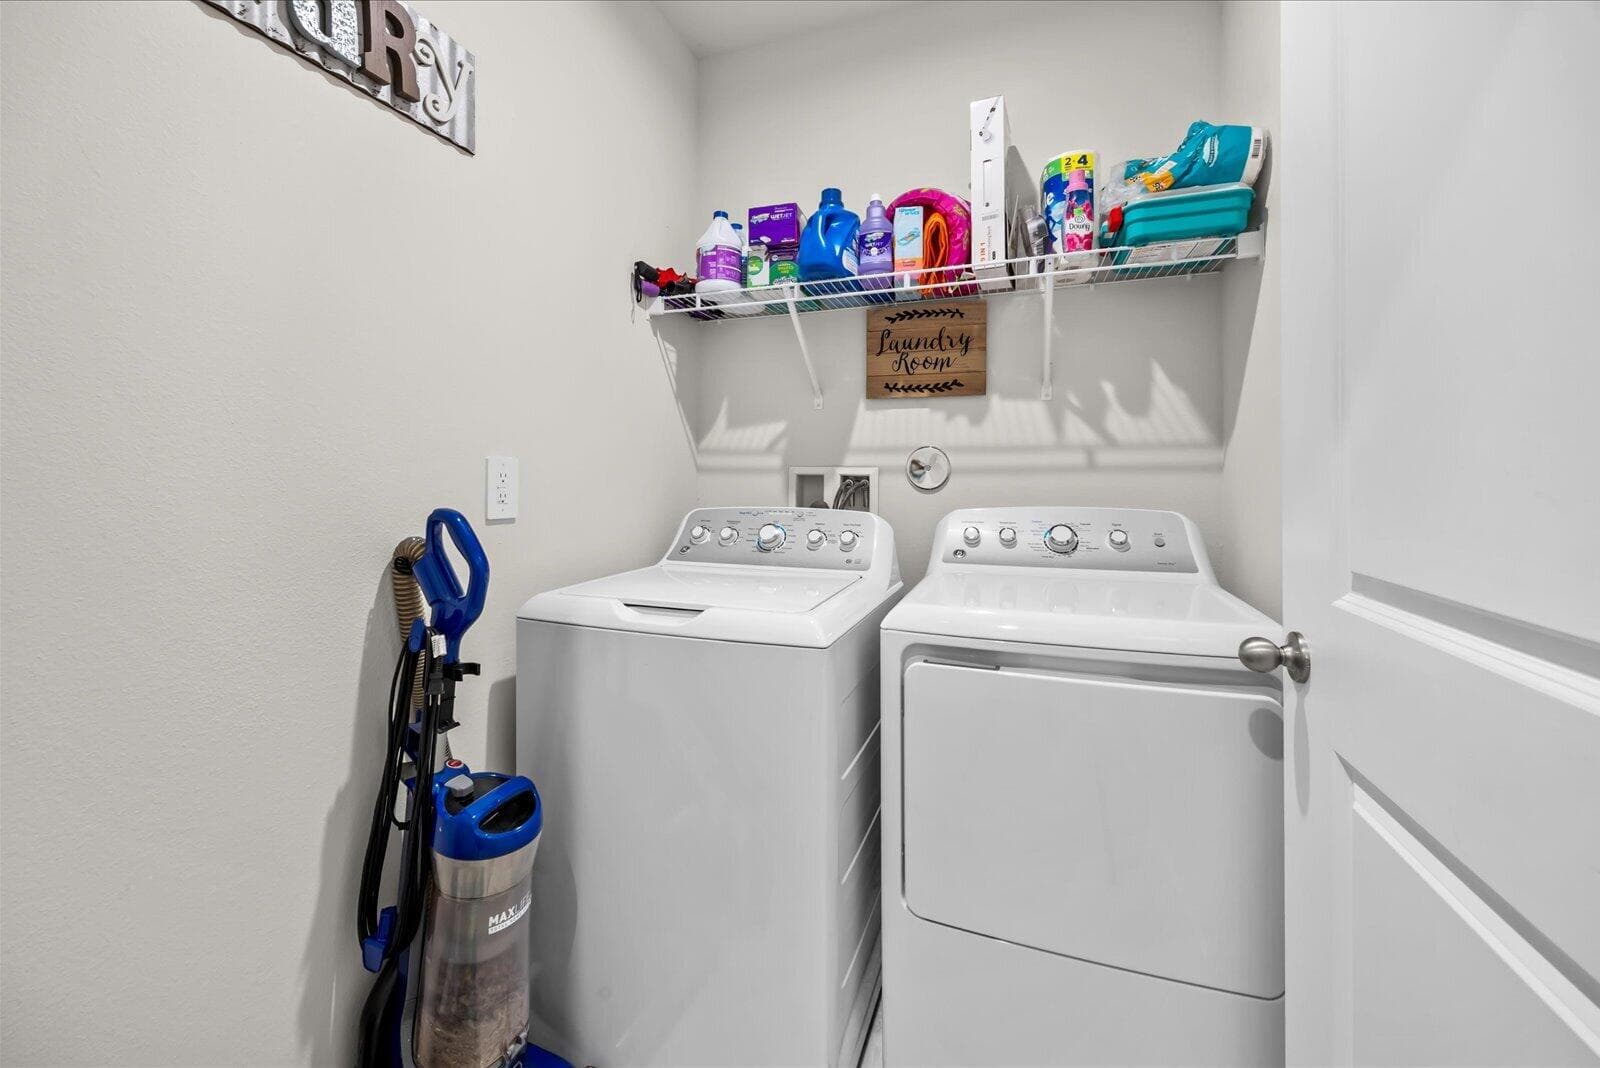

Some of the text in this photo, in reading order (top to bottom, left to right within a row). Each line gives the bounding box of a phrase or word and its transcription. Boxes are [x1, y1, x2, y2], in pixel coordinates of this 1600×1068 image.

[1065, 154, 1088, 166] 2 4
[1069, 222, 1091, 231] Downy
[875, 326, 974, 357] Laundry
[892, 351, 957, 376] Room
